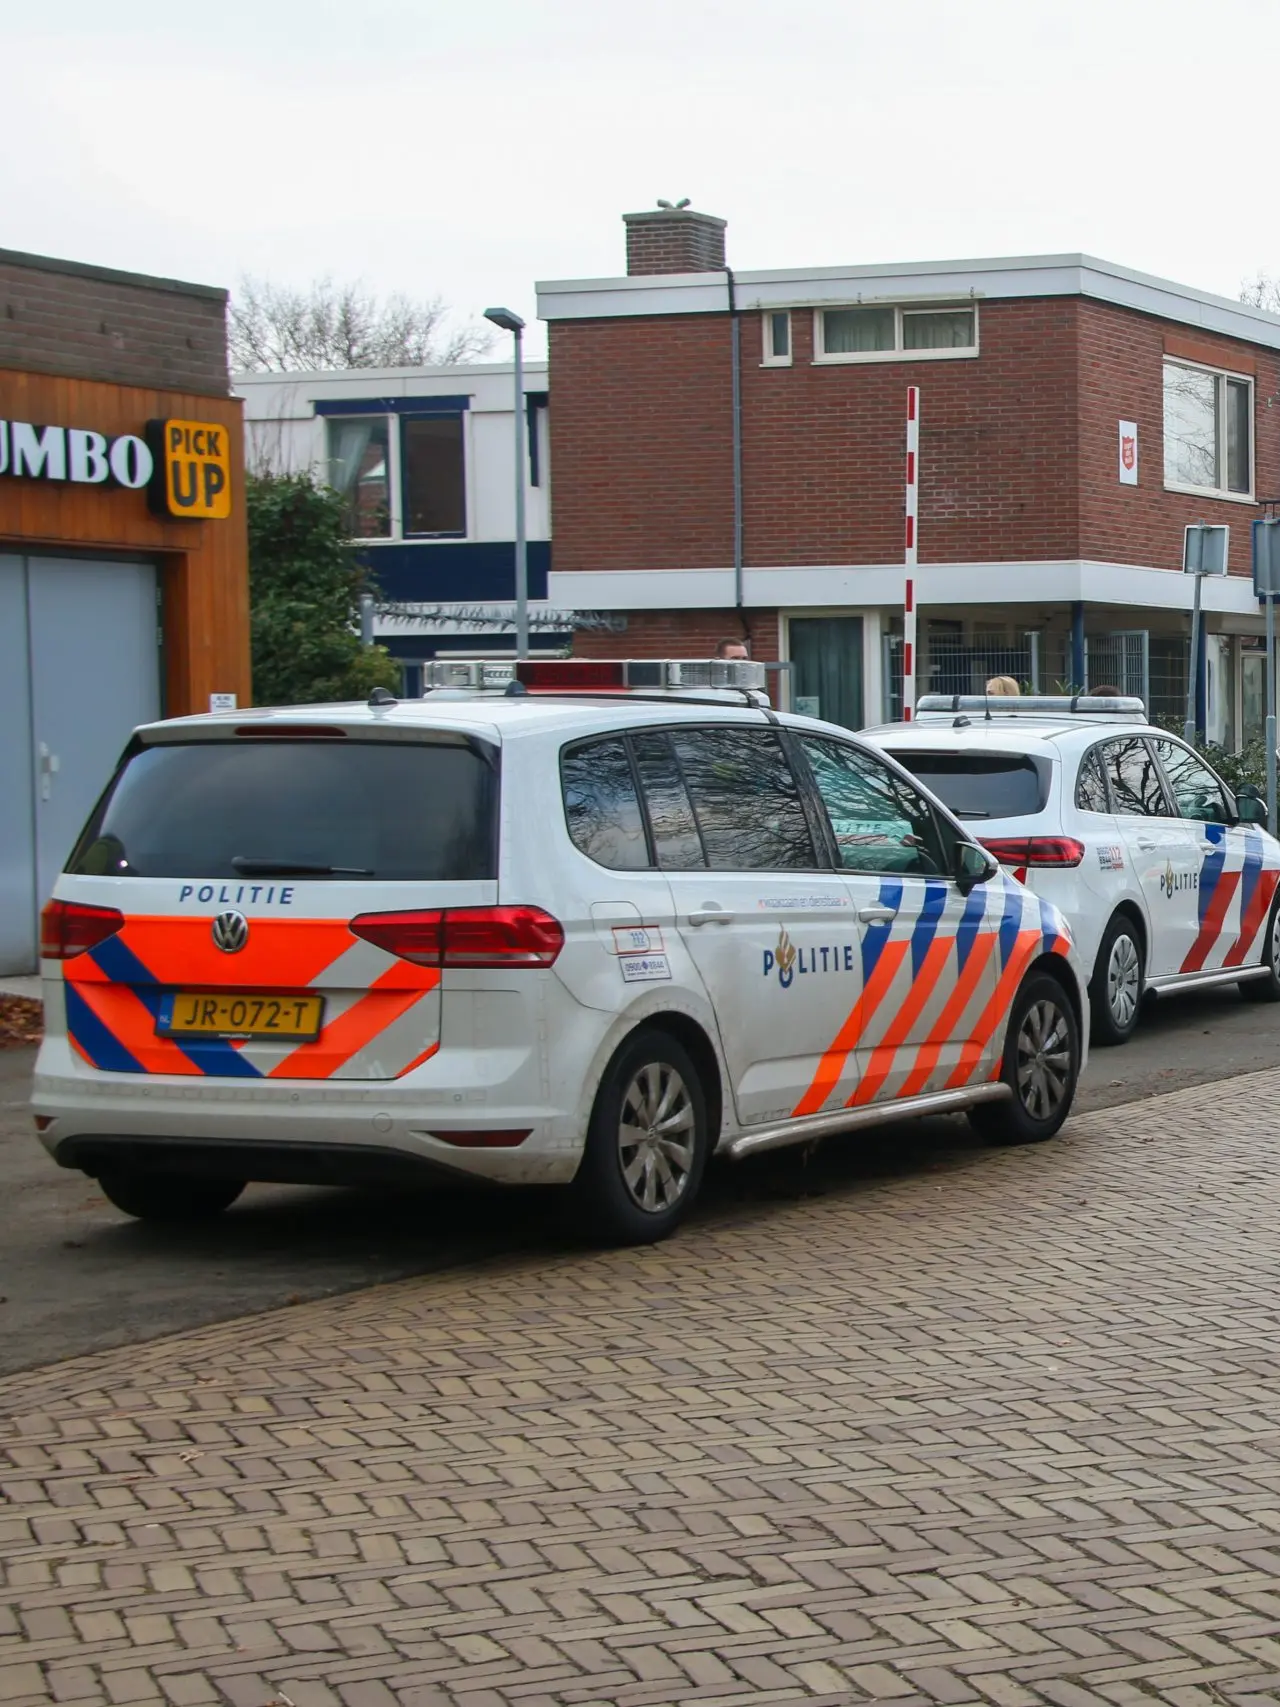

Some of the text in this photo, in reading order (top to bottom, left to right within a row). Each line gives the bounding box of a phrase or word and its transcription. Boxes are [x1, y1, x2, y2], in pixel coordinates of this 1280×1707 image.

[0, 419, 154, 489] MBO
[170, 427, 222, 457] PICK
[171, 459, 226, 508] UP
[179, 885, 295, 905] POLITIE
[1160, 872, 1198, 899] POLITIE
[763, 945, 854, 989] POLITIE
[185, 999, 309, 1029] JR-072-T
